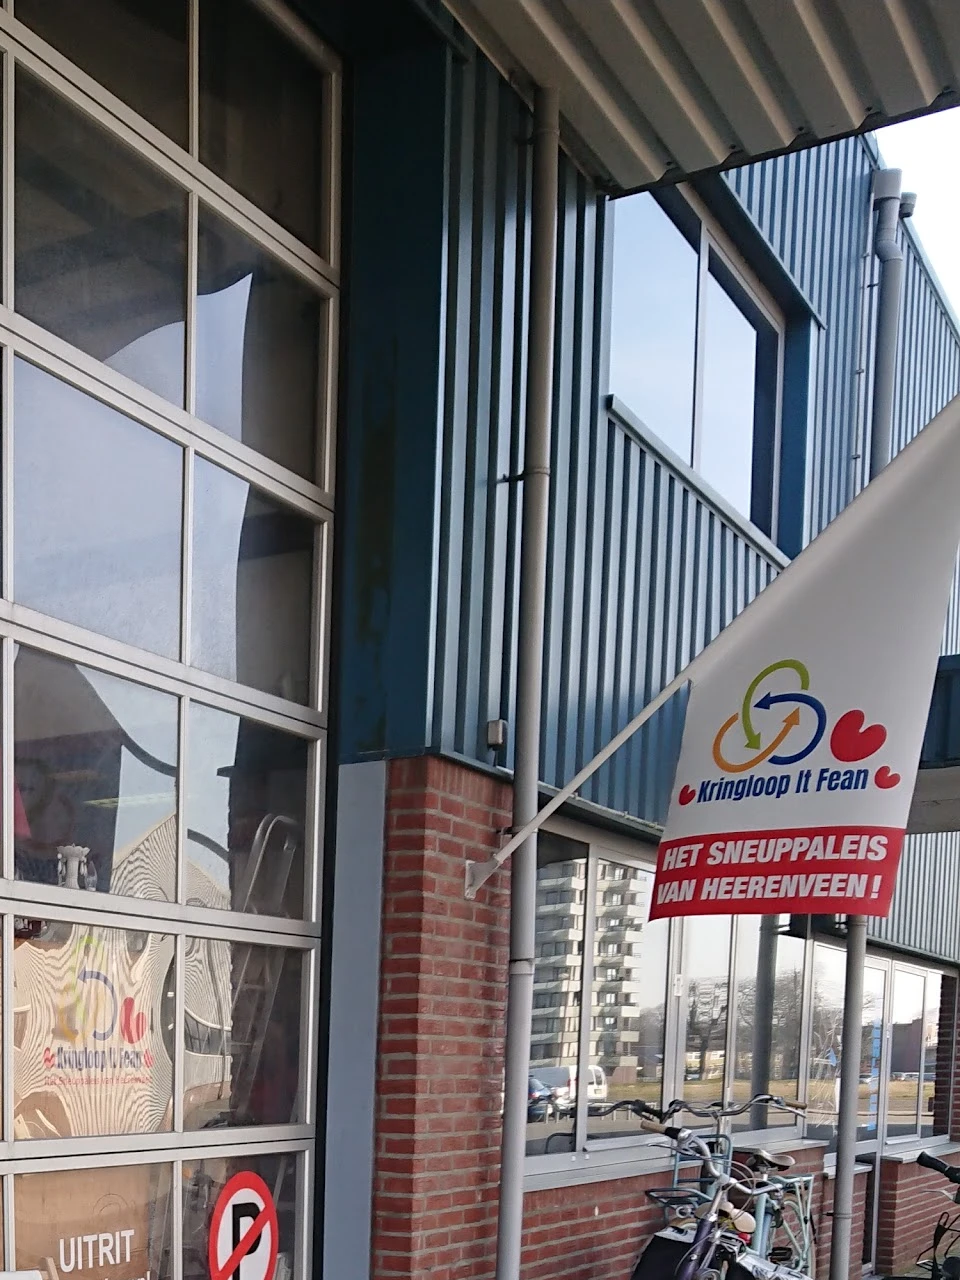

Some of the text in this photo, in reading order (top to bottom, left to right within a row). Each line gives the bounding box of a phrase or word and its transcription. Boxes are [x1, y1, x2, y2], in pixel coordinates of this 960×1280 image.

[696, 767, 869, 803] Kringloop It Fean
[662, 835, 888, 872] HET SNEUPPALEIS
[656, 877, 697, 905] VAN
[59, 1229, 135, 1273] UITRIT
